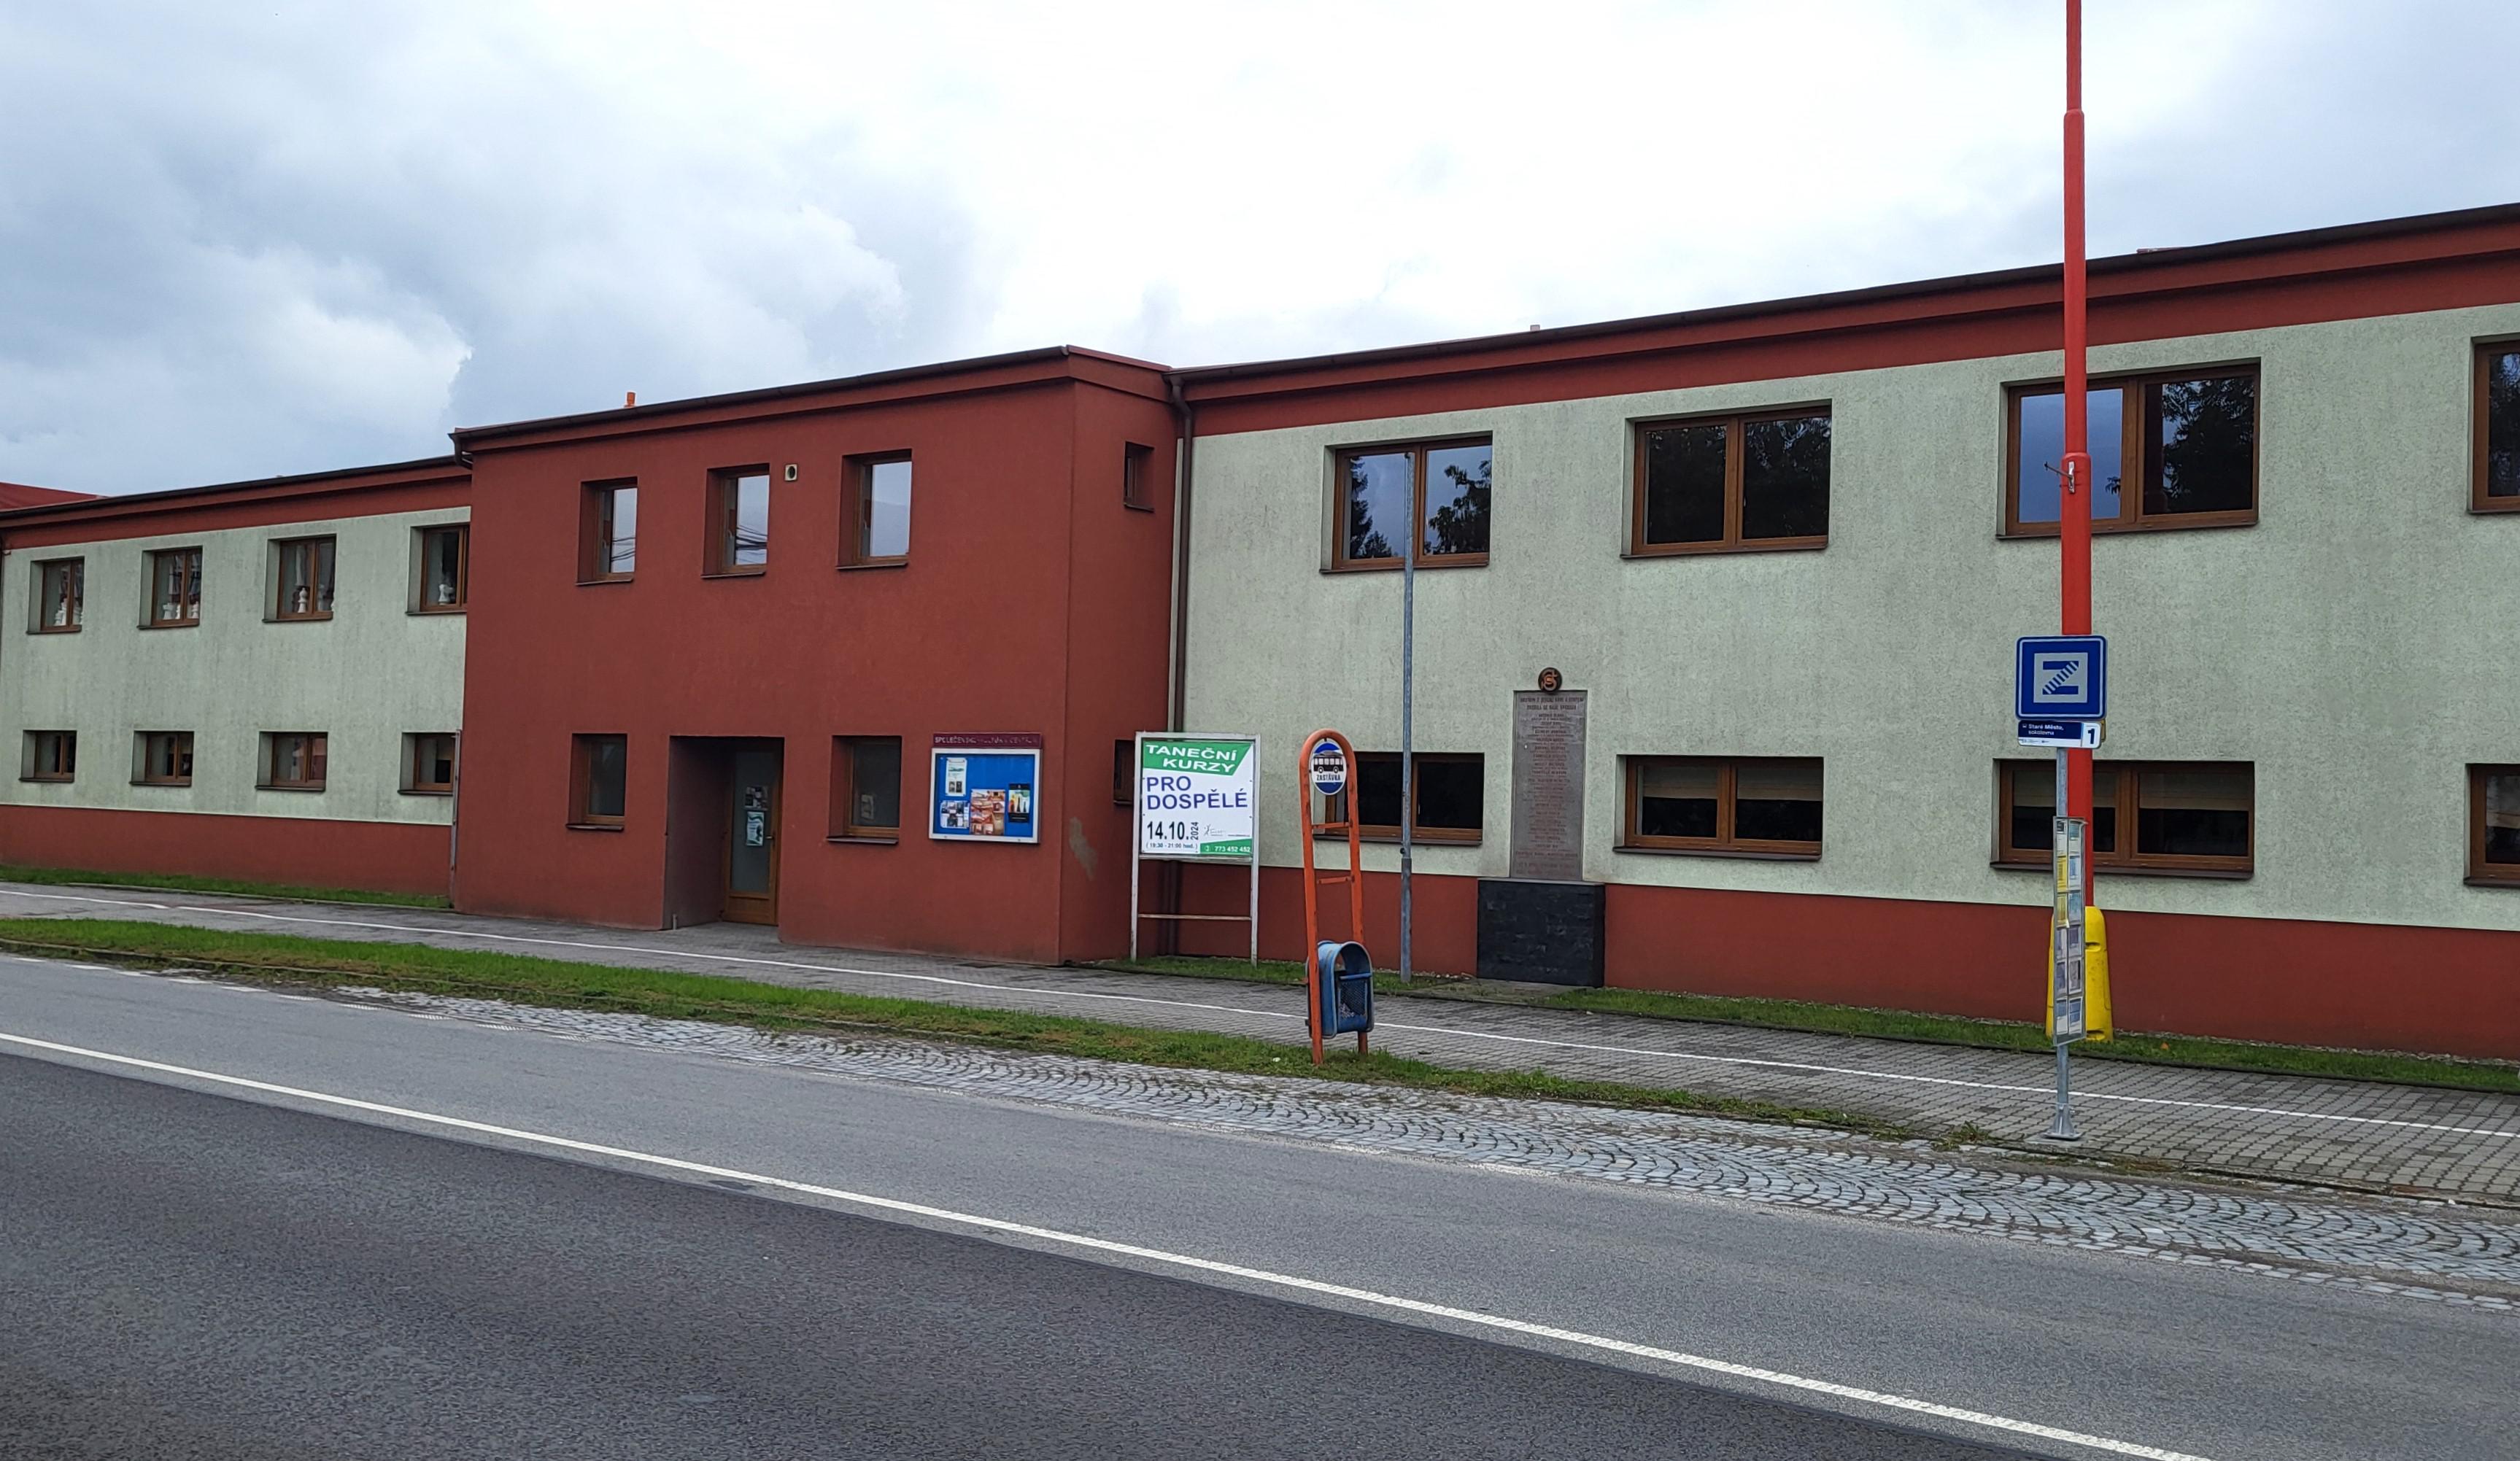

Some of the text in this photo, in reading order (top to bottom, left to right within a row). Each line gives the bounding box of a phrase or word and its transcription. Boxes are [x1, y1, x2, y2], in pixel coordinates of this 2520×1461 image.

[2087, 728, 2095, 745] 1
[1145, 744, 1238, 761] TANEČNÍ
[1163, 758, 1235, 773] KURZY
[1146, 775, 1191, 792] PRO
[1147, 788, 1248, 810] DOSPĚLÉ
[1147, 821, 1189, 840] 14.10.
[1190, 821, 1199, 840] 2024
